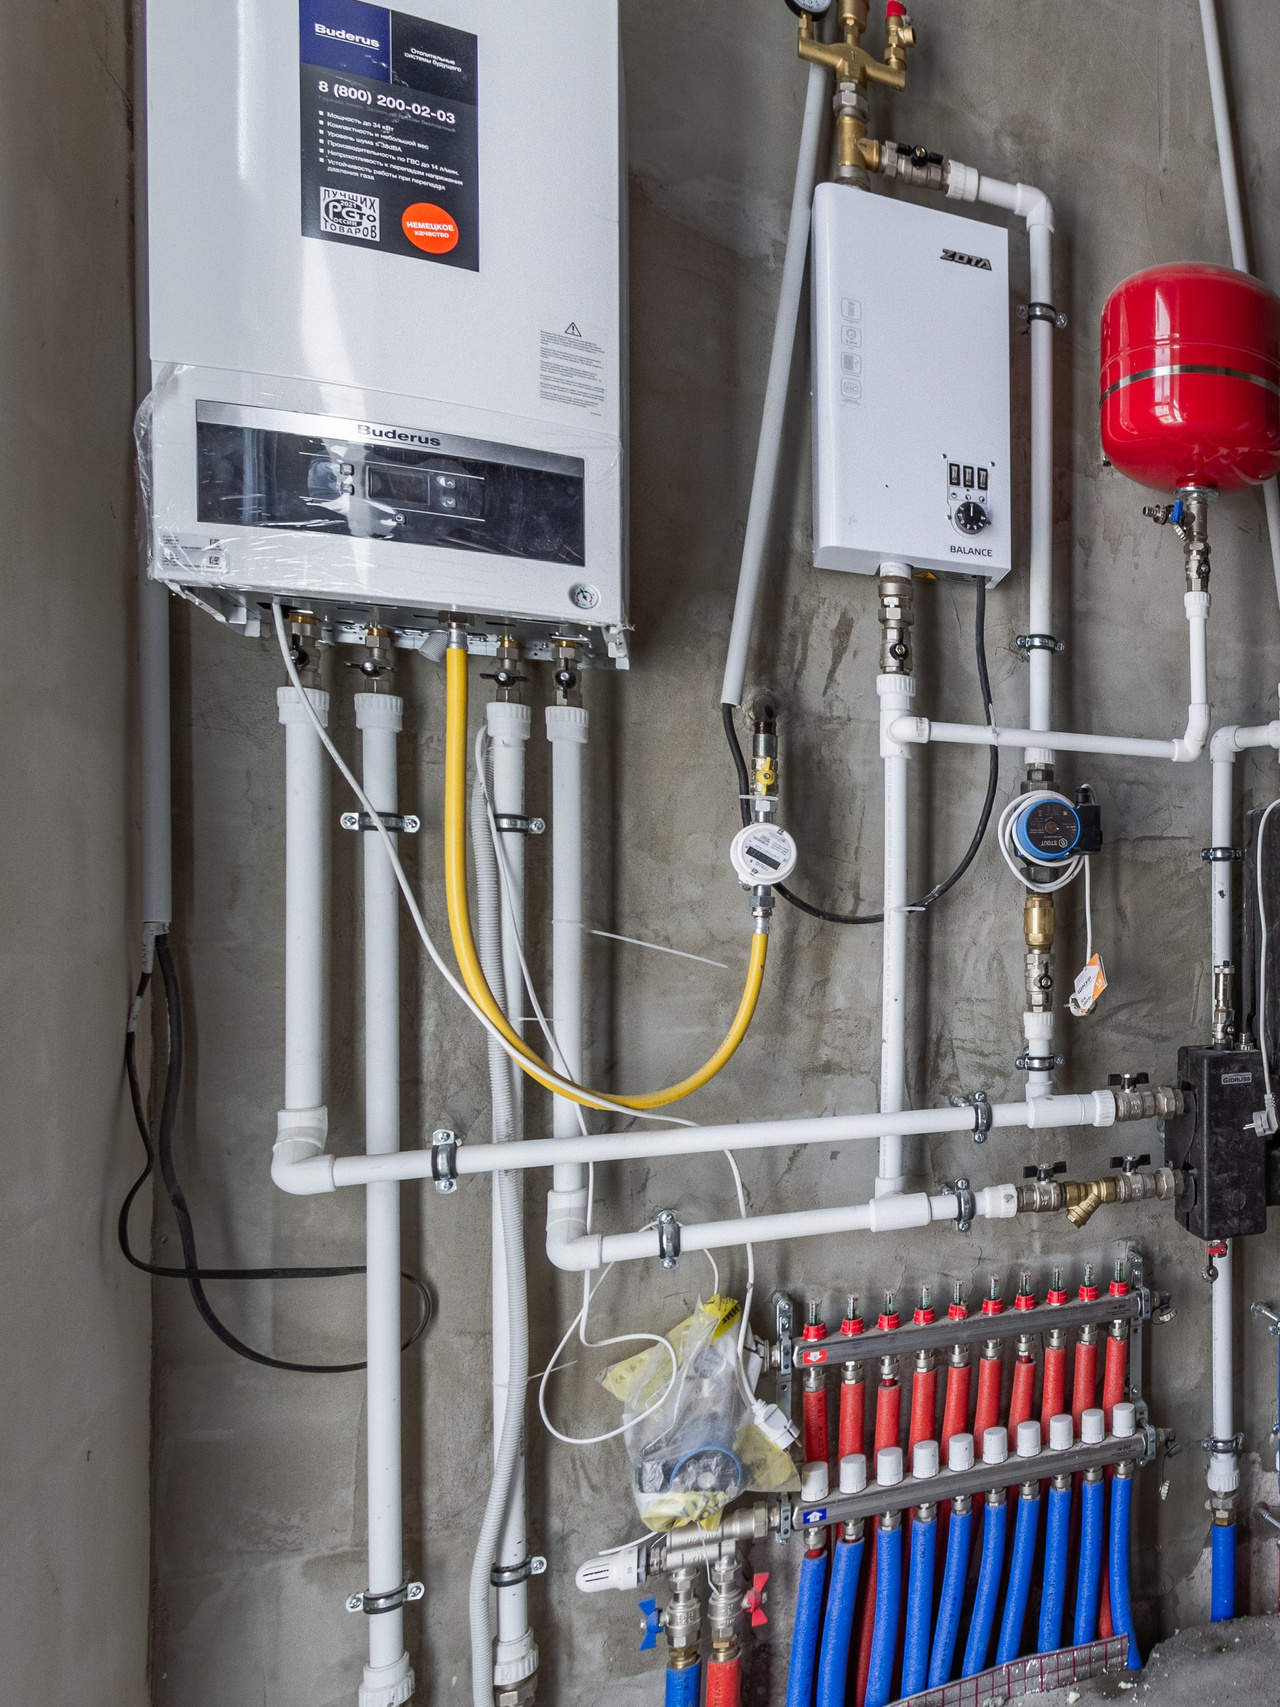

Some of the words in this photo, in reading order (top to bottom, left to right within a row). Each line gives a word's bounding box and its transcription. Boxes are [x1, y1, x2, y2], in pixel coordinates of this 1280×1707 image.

[314, 23, 380, 48] Buderus
[404, 52, 432, 65] системы
[432, 58, 462, 73] будущего
[409, 47, 456, 66] Отопительные
[318, 80, 329, 92] 8
[333, 84, 372, 105] (800)
[376, 94, 456, 124] 200-02-03
[326, 111, 362, 124] Мощность
[326, 121, 374, 136] Компактность
[380, 134, 416, 147] небольшой
[417, 142, 430, 150] вес
[326, 130, 355, 142] Уровень
[355, 137, 374, 146] шума
[327, 140, 396, 160] Производительность
[406, 157, 421, 166] ГВС
[327, 149, 384, 168] Неприхотливость
[390, 164, 424, 176] перепадам
[425, 172, 464, 186] напряжения
[327, 166, 359, 178] давления
[360, 173, 375, 181] газа
[327, 158, 373, 173] Устойчивость
[373, 168, 398, 180] работы
[398, 174, 411, 182] при
[411, 178, 446, 191] перепадах
[323, 188, 376, 214] ЛУЧШИХ
[340, 200, 357, 208] 2021
[322, 216, 377, 239] ТОВАРОВ
[406, 221, 454, 232] НЕМЕЦКОЕ
[414, 230, 450, 238] качество
[939, 248, 993, 272] ZOTA
[357, 424, 441, 446] Buderus
[950, 545, 993, 558] BALANCE
[1222, 1076, 1251, 1084] GIDRUSS
